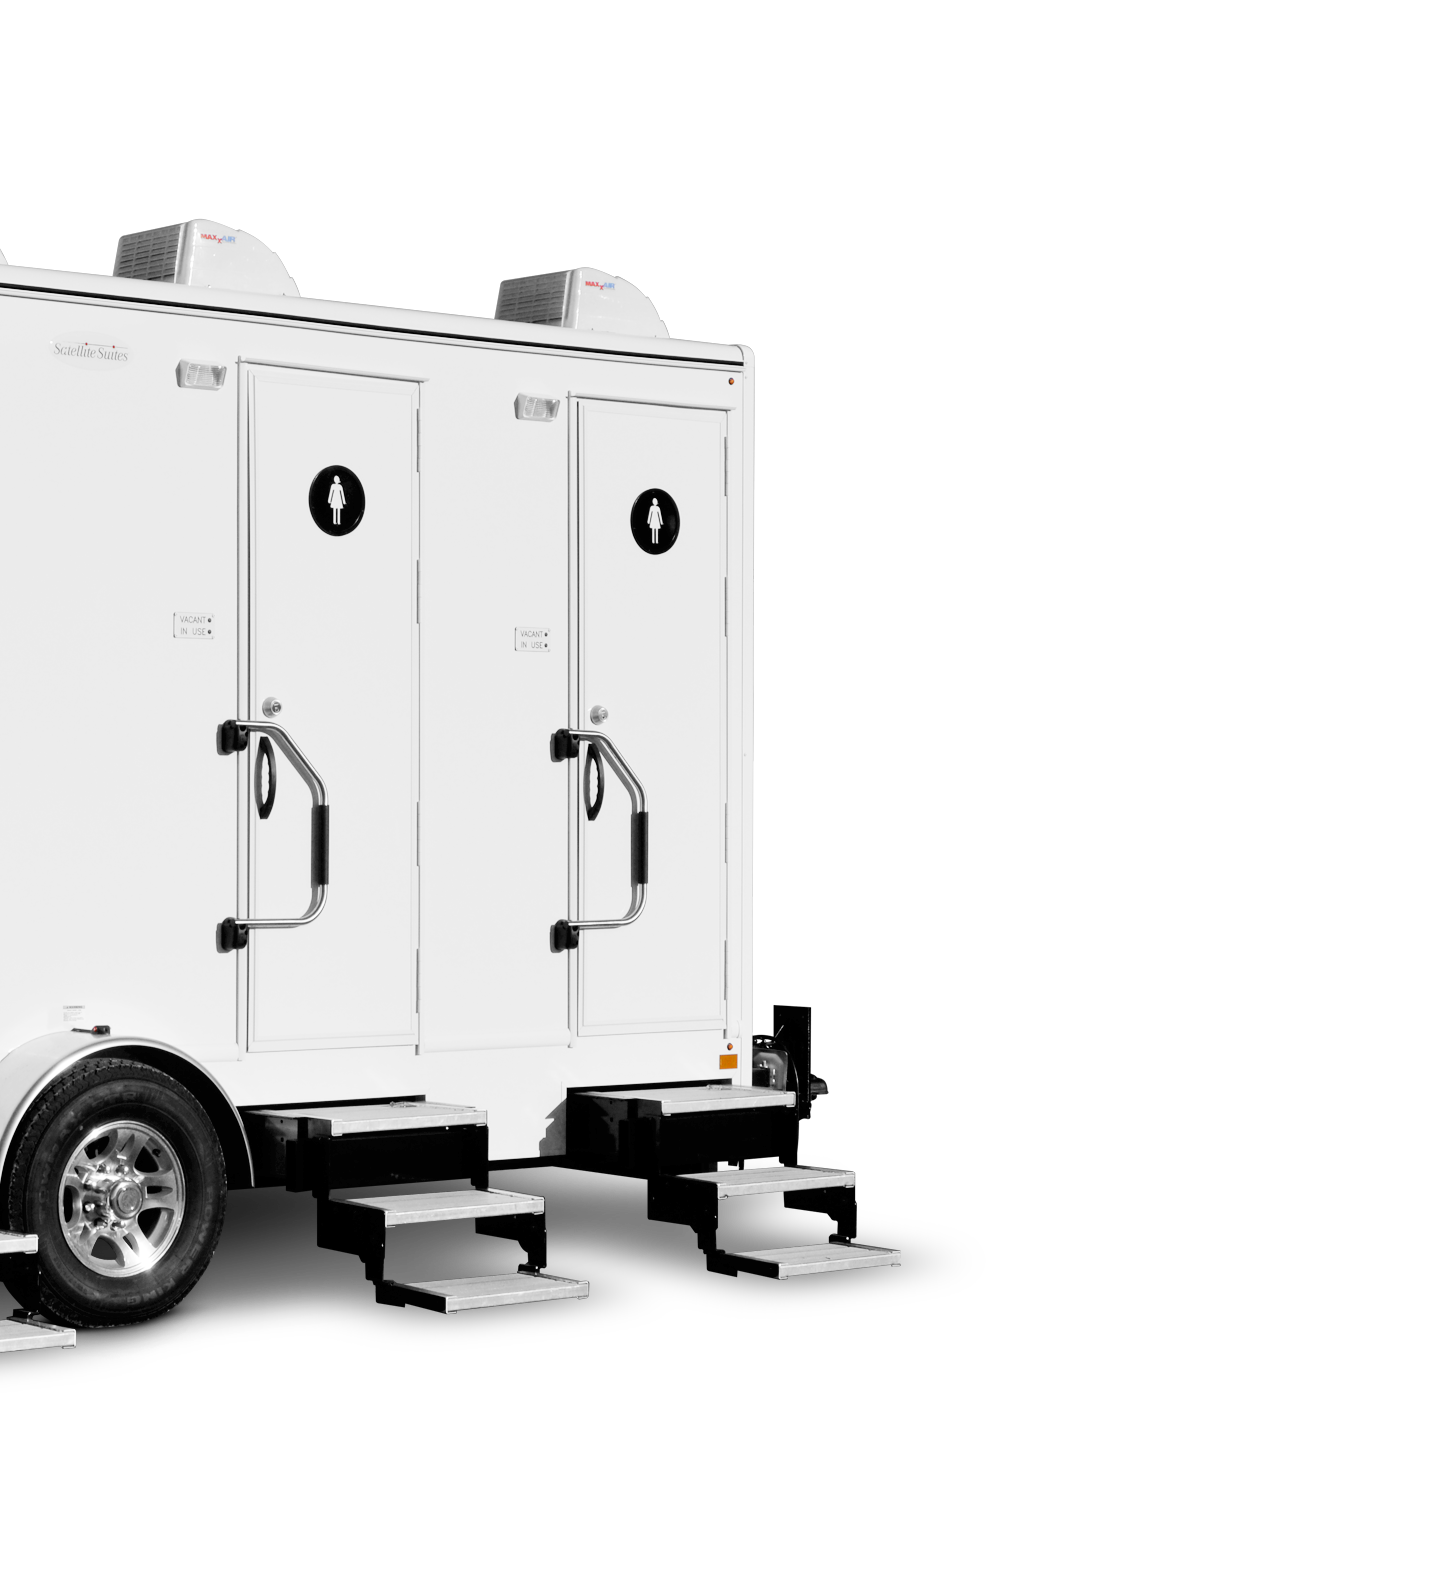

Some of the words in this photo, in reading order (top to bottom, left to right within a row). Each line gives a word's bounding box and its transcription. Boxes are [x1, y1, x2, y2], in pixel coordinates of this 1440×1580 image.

[53, 342, 97, 359] Satellite
[97, 347, 129, 362] Suites
[179, 615, 206, 624] VACANT
[180, 627, 188, 635] IN
[192, 627, 206, 636] USE
[520, 630, 543, 638] VACANT
[520, 641, 527, 649] IN
[531, 641, 543, 649] USE
[179, 1186, 214, 1276] POWER
[126, 1276, 176, 1306] KING
